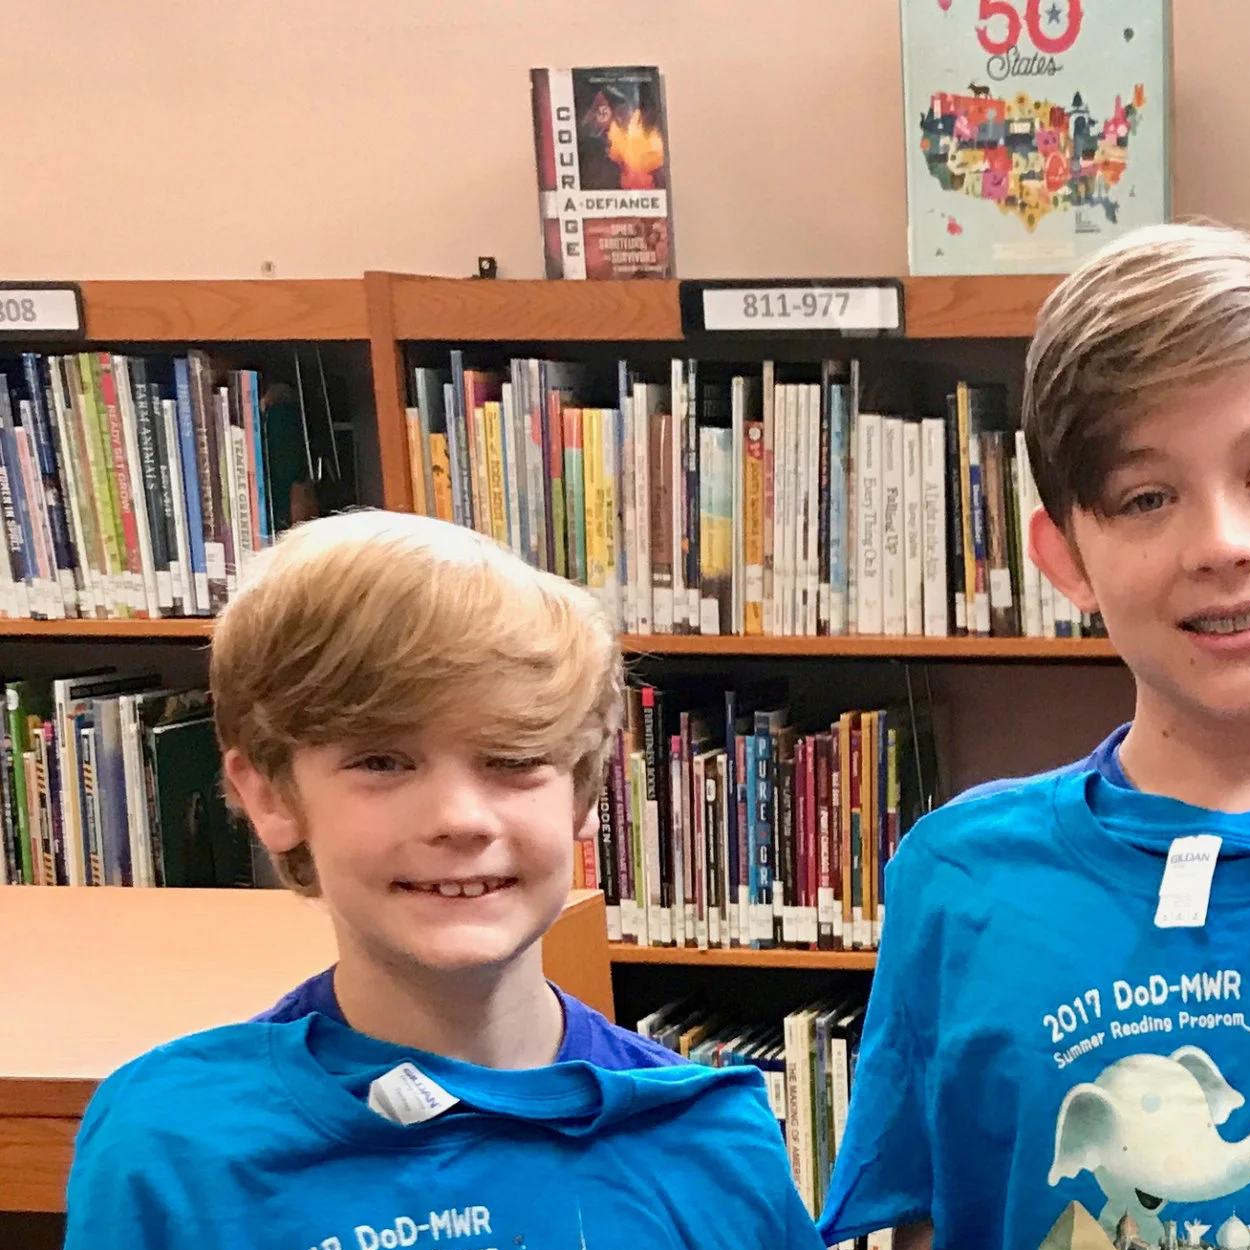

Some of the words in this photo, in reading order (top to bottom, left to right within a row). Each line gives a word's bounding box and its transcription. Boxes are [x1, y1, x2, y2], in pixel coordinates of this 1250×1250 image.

[975, 0, 1083, 54] 50
[987, 45, 1064, 81] States
[586, 197, 660, 209] DEFIANCE
[742, 292, 850, 318] 811-977
[1170, 852, 1210, 864] GILDAN
[1043, 988, 1101, 1043] 2017
[1113, 970, 1241, 1011] DoD-MWR
[1054, 1030, 1105, 1069] Summer
[1110, 1015, 1172, 1039] Reading
[1179, 1011, 1245, 1030] Program
